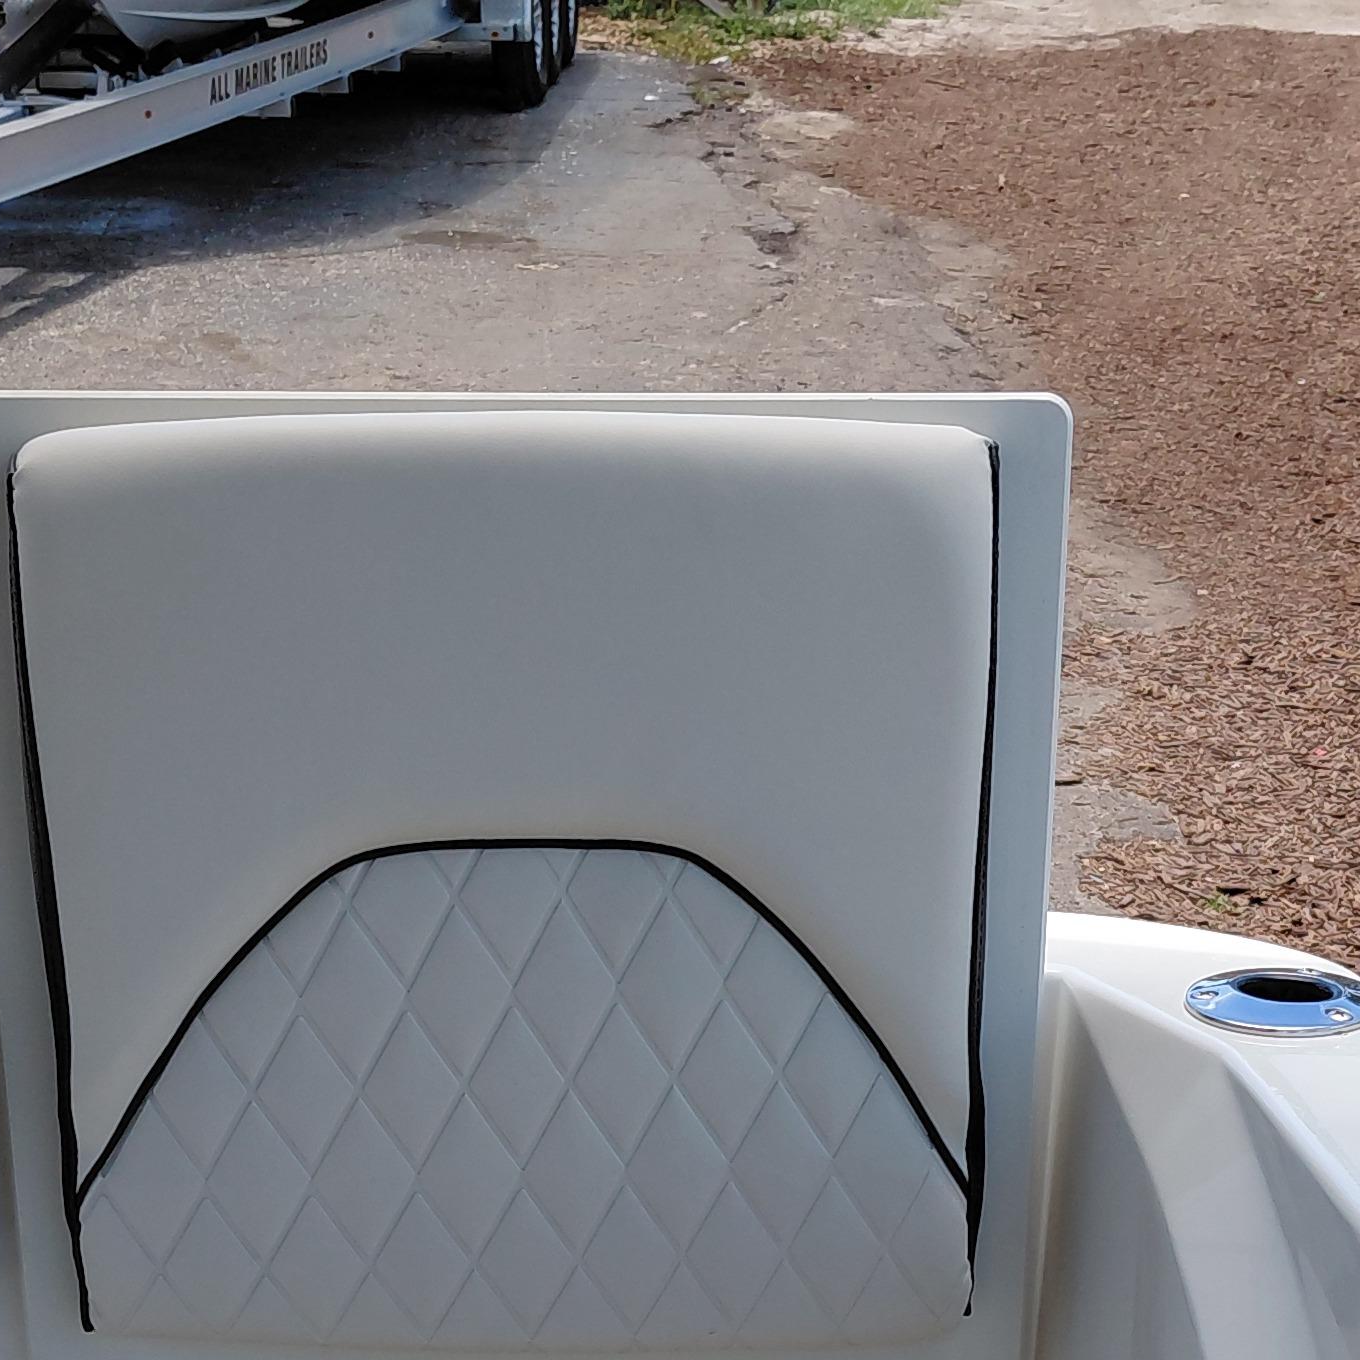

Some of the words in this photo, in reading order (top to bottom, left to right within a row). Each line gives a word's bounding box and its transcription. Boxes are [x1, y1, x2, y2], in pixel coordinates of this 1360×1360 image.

[210, 72, 231, 105] ALL
[235, 56, 277, 95] MARINE
[281, 38, 328, 78] TRAILERS
